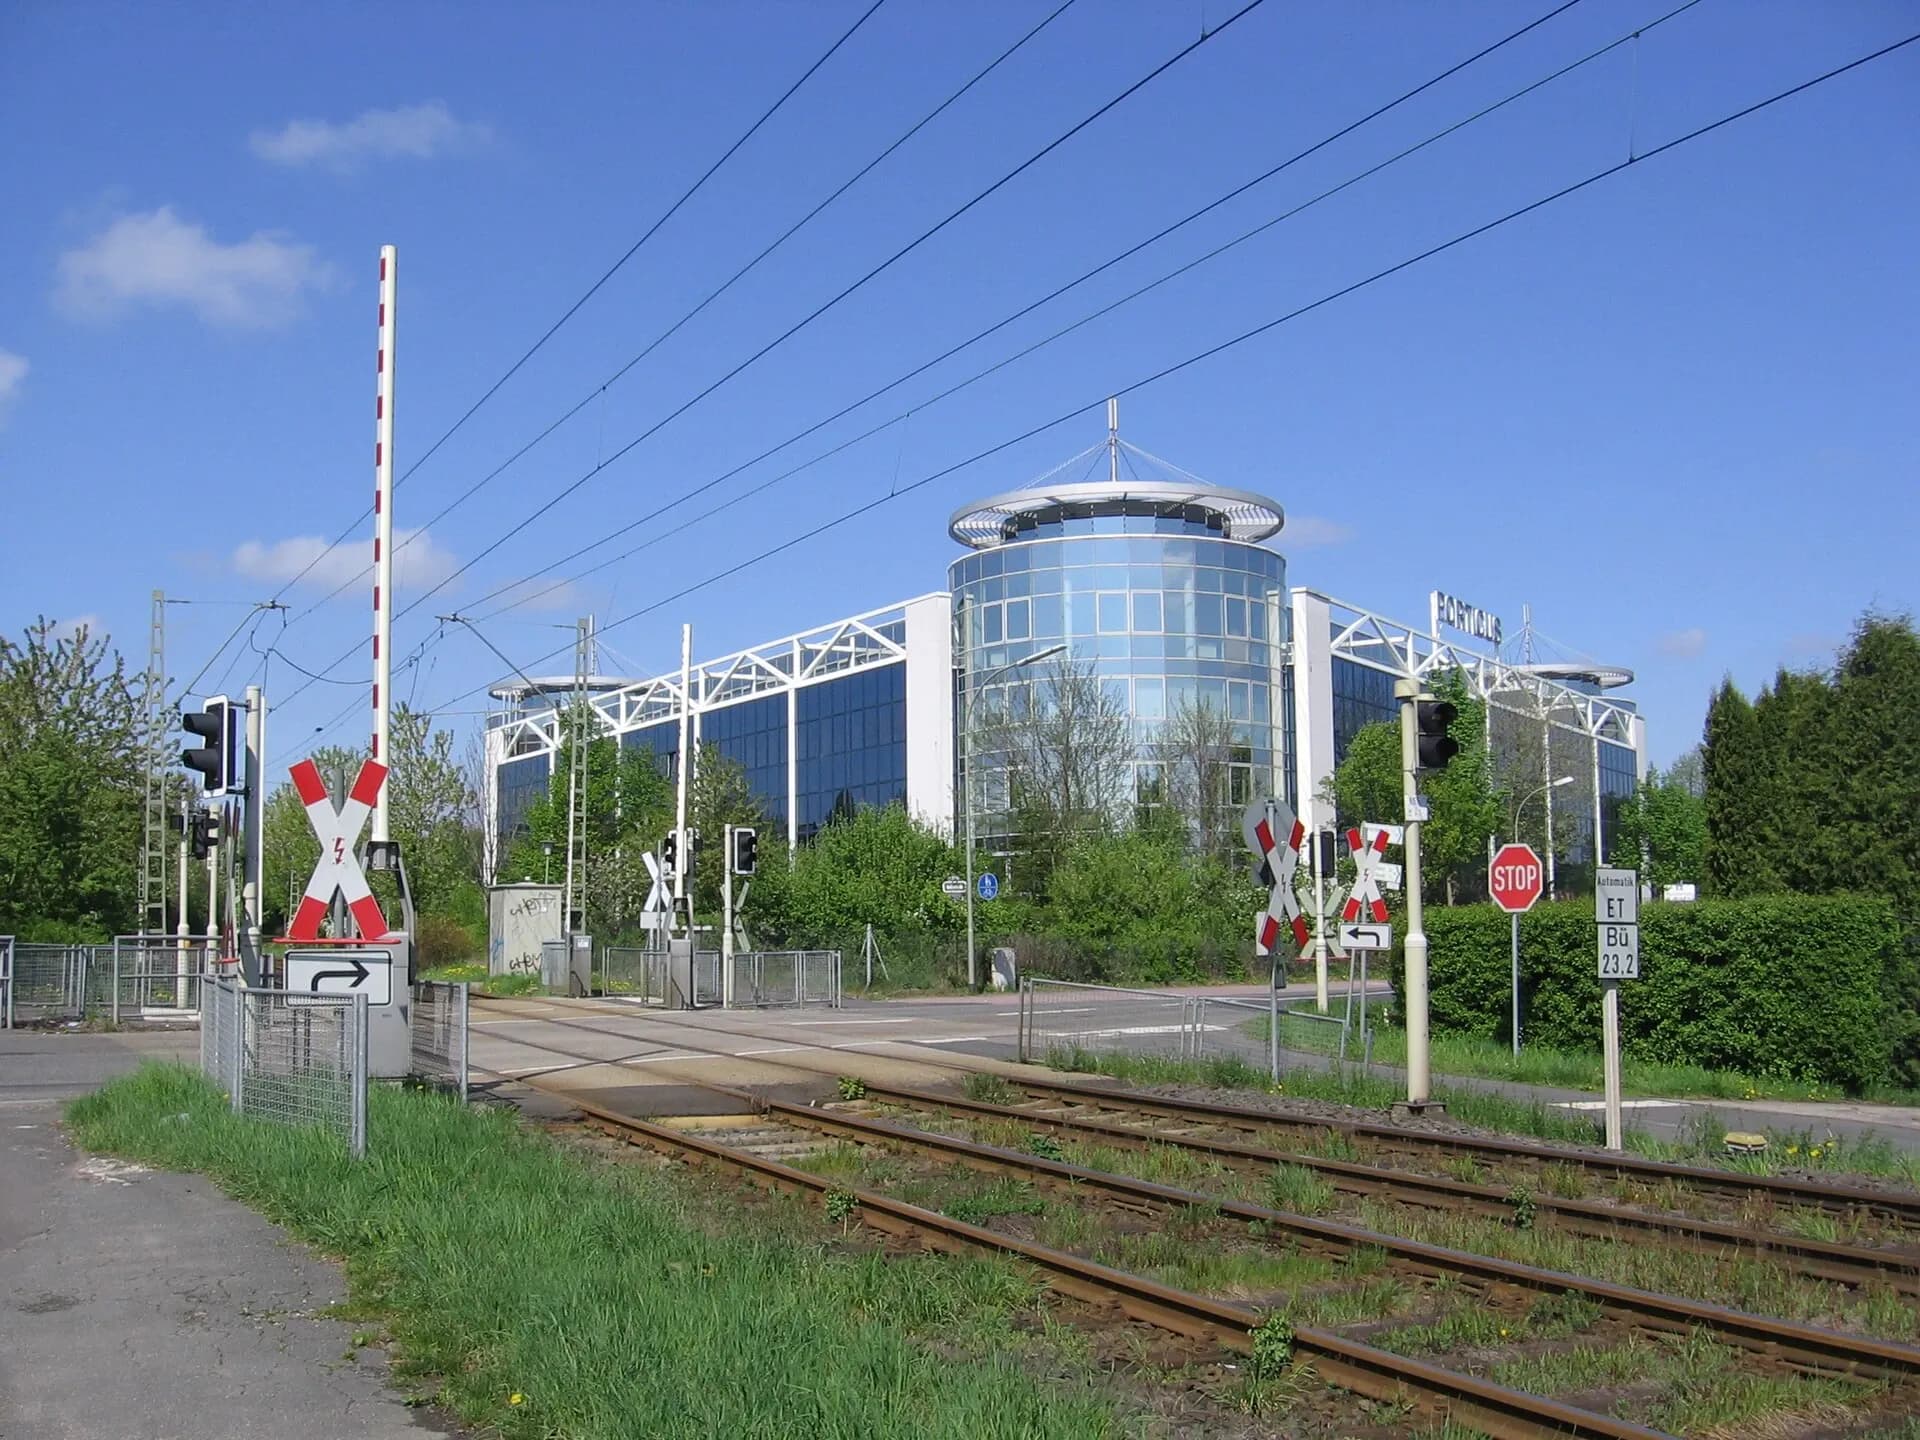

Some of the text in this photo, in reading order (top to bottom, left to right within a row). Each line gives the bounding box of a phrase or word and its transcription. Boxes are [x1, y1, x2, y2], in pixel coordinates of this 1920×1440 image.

[1436, 591, 1503, 645] PORTICUS
[1494, 864, 1537, 892] STOP
[1597, 875, 1634, 887] Automatik
[1607, 898, 1625, 918] ET
[1607, 926, 1629, 947] Bü
